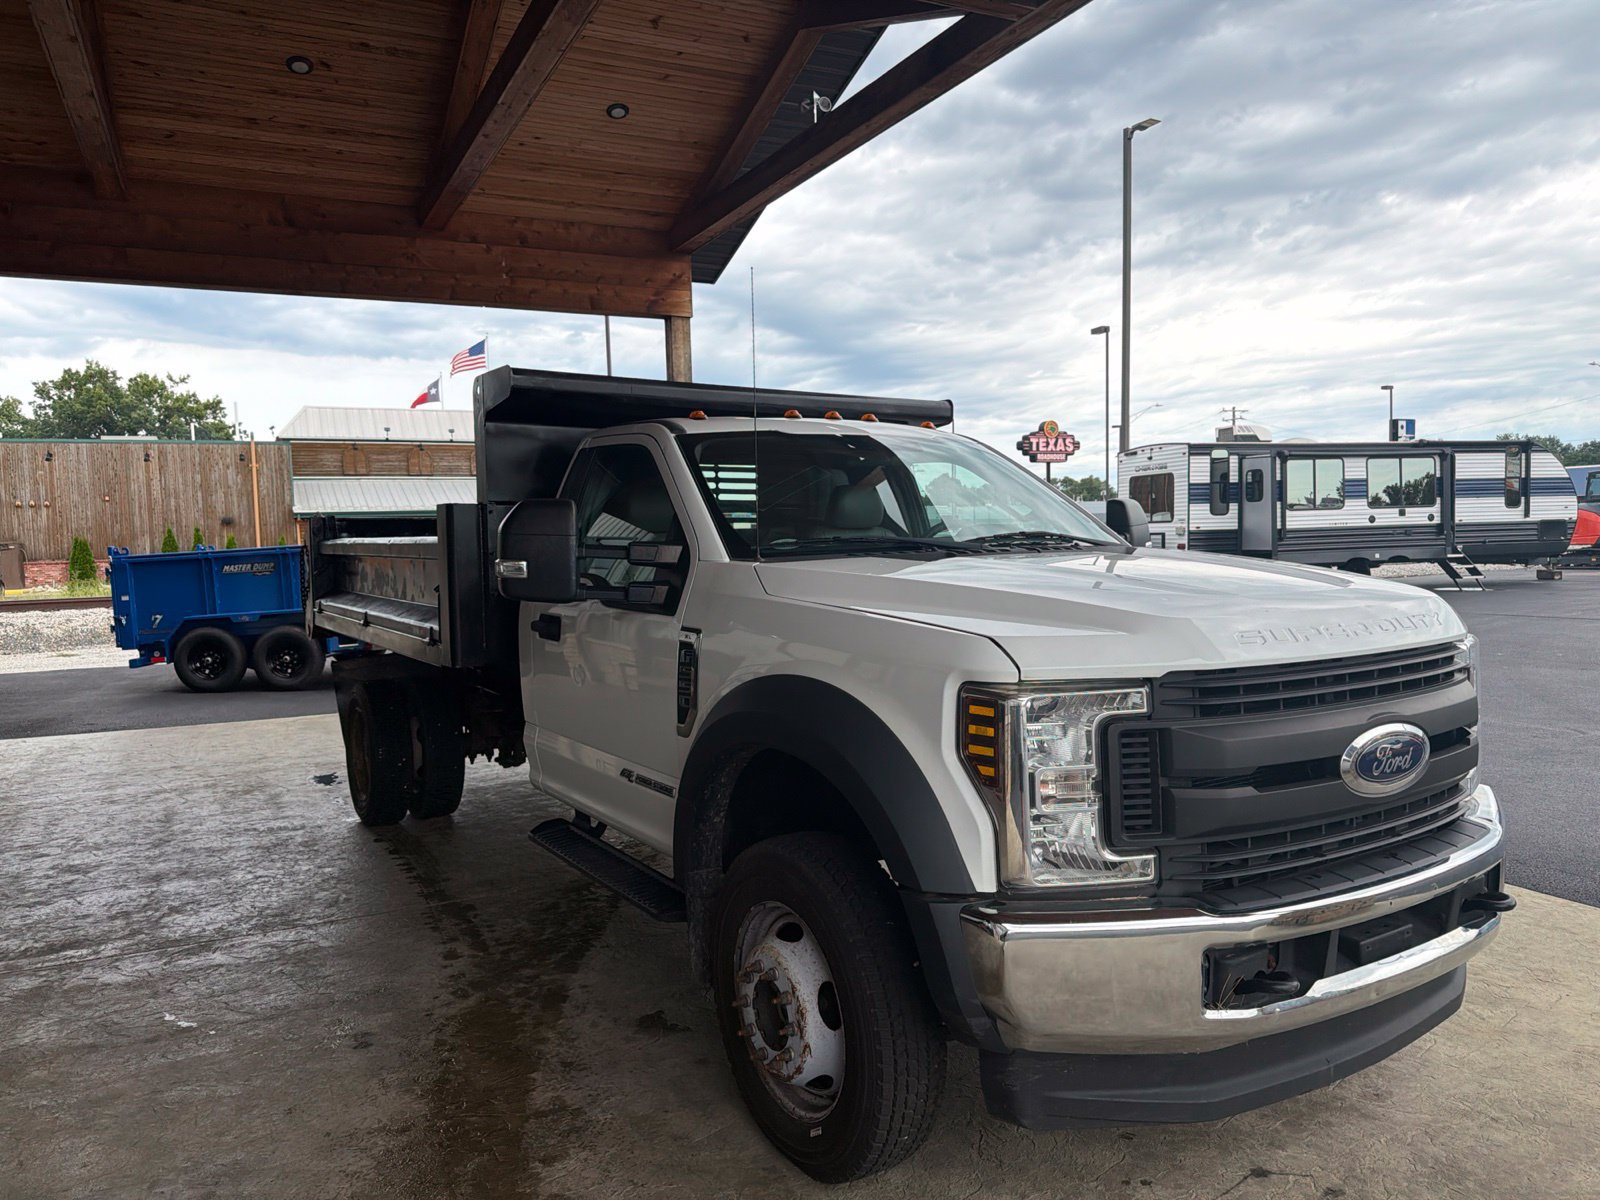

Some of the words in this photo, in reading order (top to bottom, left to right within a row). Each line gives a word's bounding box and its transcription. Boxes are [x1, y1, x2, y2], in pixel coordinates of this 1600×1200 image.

[1030, 437, 1074, 452] TEXAS
[222, 563, 252, 573] MASTER
[253, 562, 275, 571] DUMP
[151, 614, 163, 629] 7
[1233, 621, 1373, 646] SUPER
[1378, 611, 1444, 633] DUTY
[1372, 742, 1414, 776] Ford
